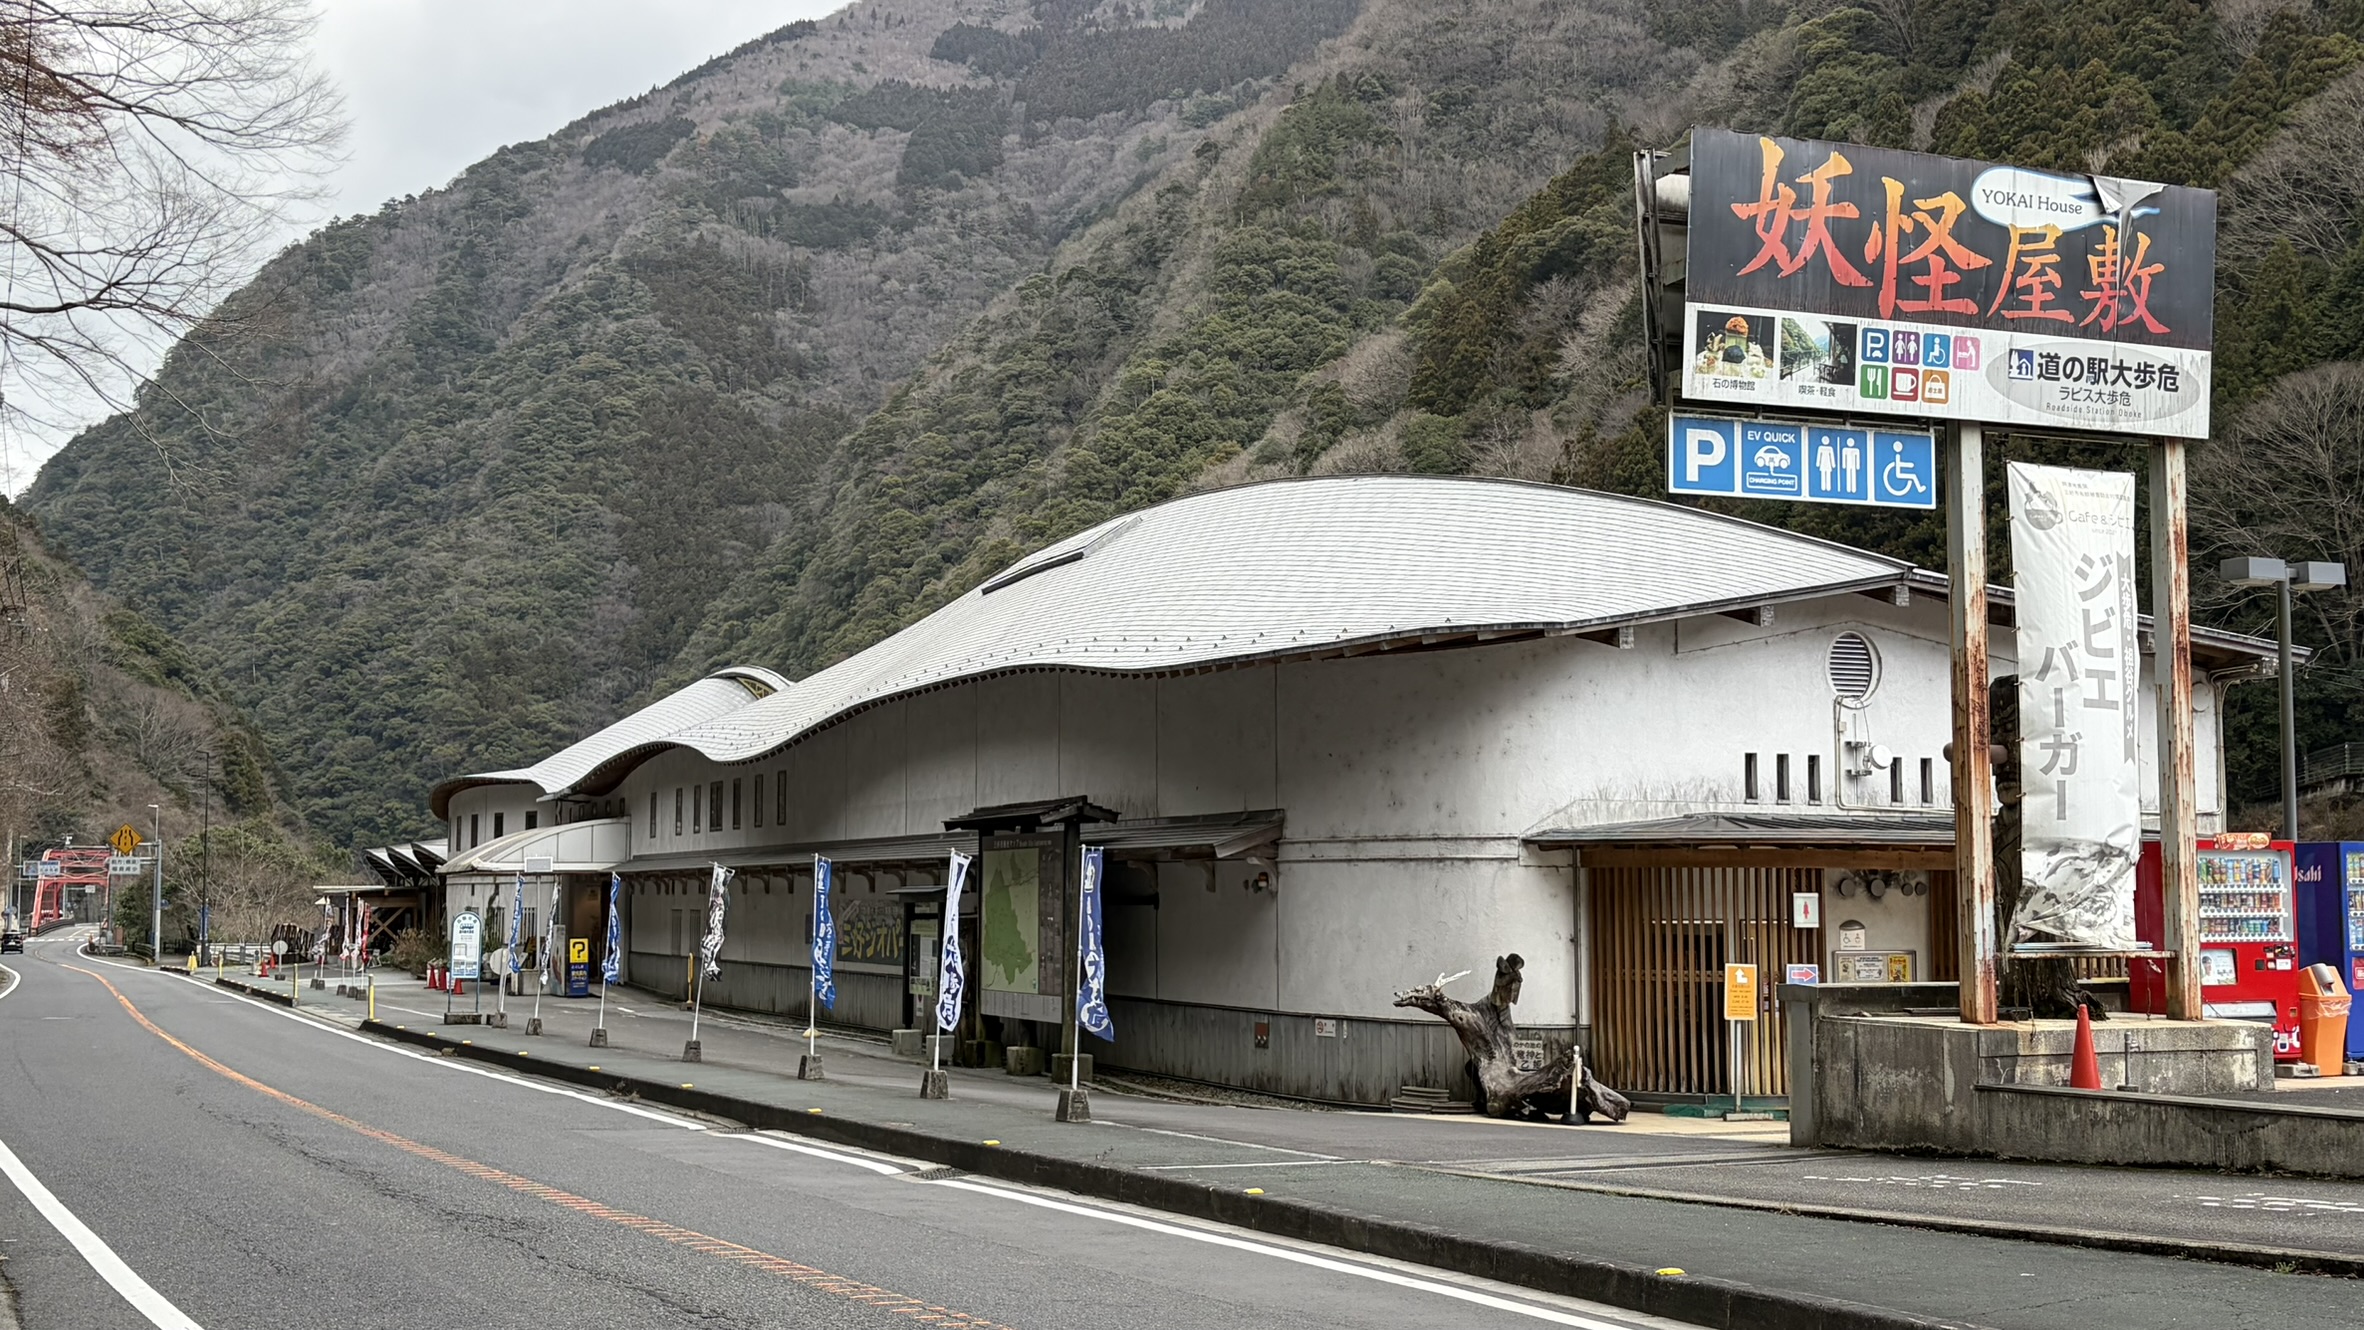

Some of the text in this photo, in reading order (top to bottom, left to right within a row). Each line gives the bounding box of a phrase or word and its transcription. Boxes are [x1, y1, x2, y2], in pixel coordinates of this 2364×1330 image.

[1982, 188, 2083, 215] YOKAI House
[1731, 136, 2171, 334] 妖怪屋敷
[1712, 377, 1756, 392] 石の博物館
[2037, 352, 2180, 393] 道の駅大歩危
[2058, 386, 2132, 407] ラピス大歩危
[2046, 402, 2142, 419] Roadside Station Oboke
[1747, 430, 1796, 444] EV QUICK
[1686, 428, 1727, 482] P
[1749, 477, 1795, 486] CHARGING POINT
[2074, 552, 2120, 711] ジビエ
[2034, 639, 2083, 821] バーガー
